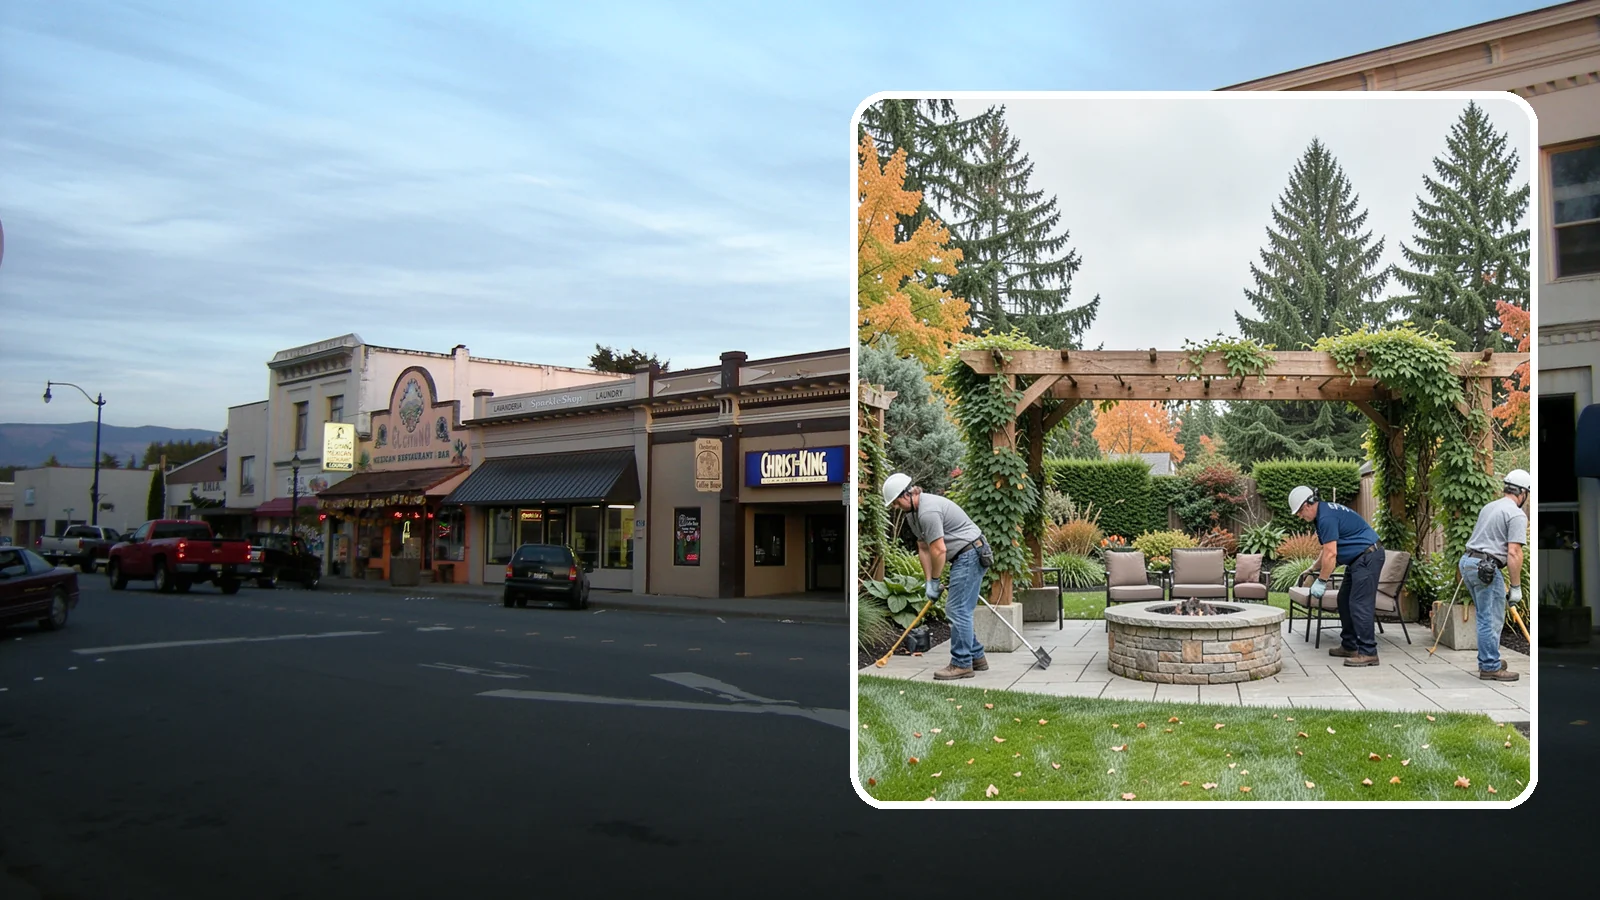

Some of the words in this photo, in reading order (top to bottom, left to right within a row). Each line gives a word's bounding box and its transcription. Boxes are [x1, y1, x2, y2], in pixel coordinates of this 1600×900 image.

[530, 398, 561, 408] Sparkle
[561, 394, 582, 407] Shop
[595, 389, 623, 399] LAUNDRY
[494, 402, 523, 412] LAVANDERIA
[374, 456, 396, 464] MEXICAN
[397, 452, 433, 462] RESTAURANT
[438, 450, 450, 459] BAR
[761, 452, 796, 477] CHRIST
[799, 450, 827, 476] KING
